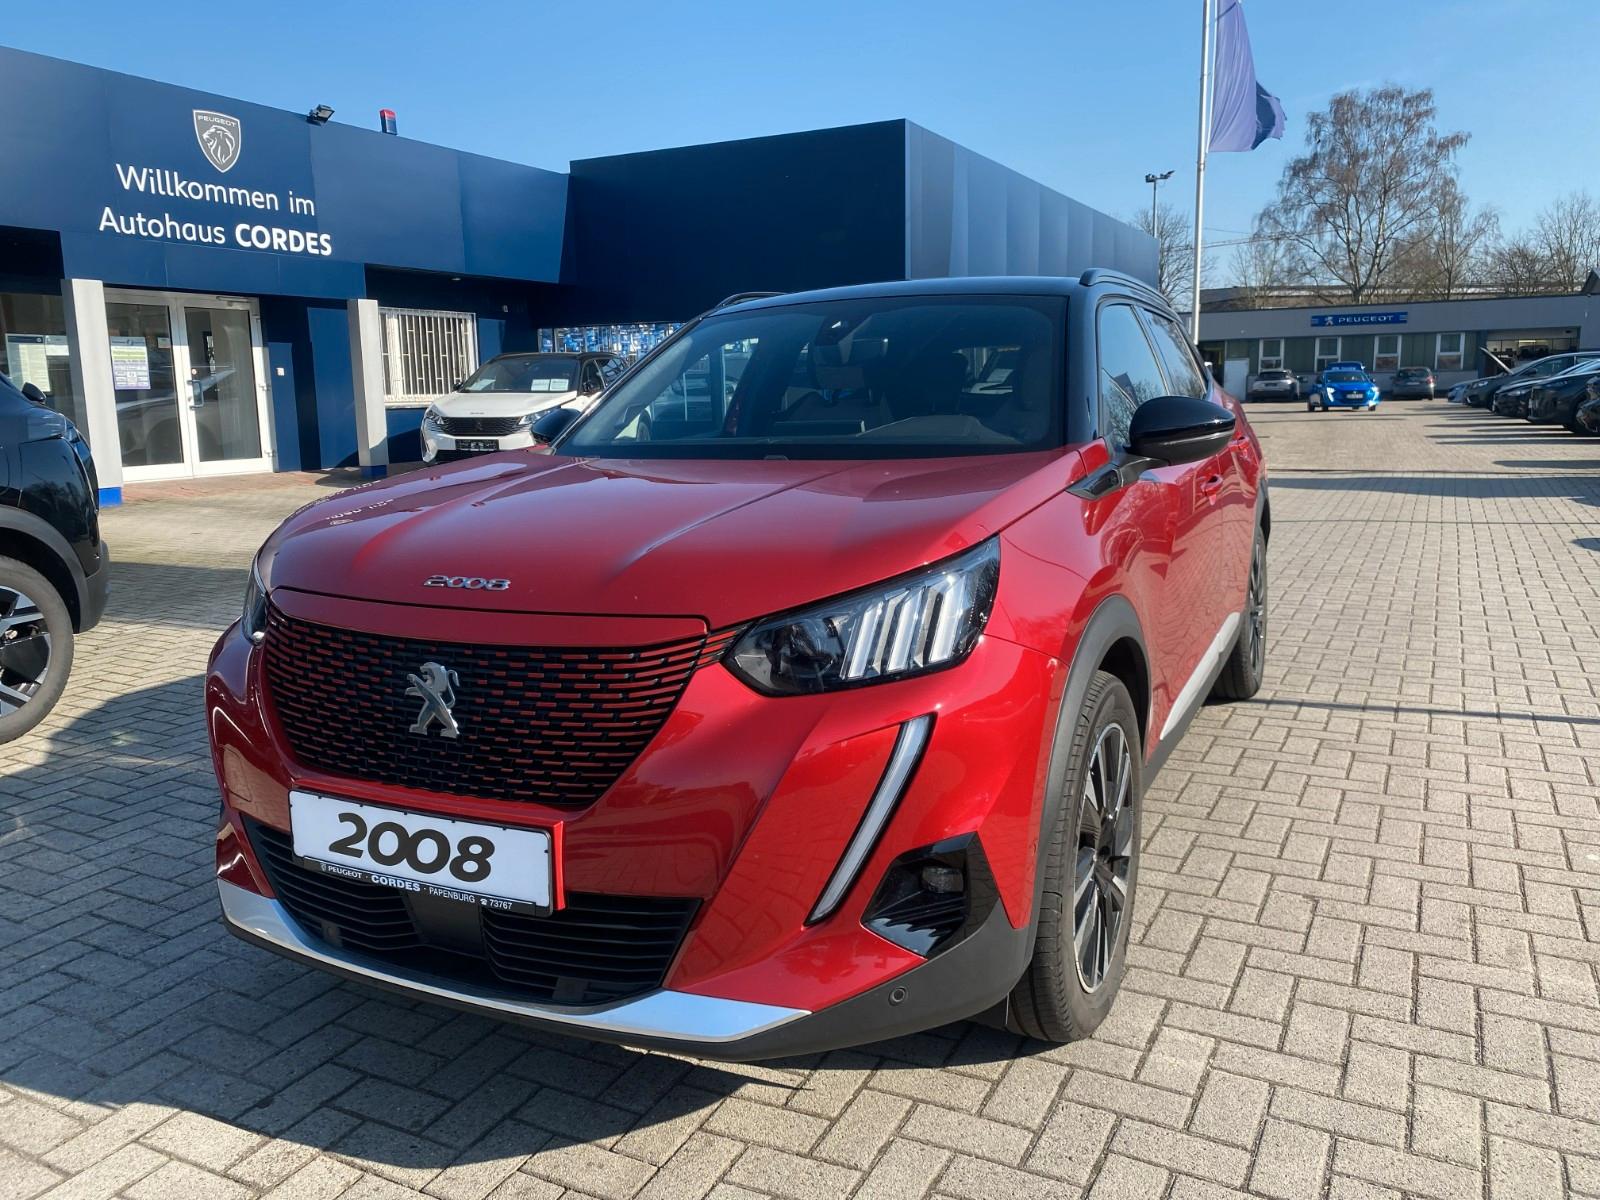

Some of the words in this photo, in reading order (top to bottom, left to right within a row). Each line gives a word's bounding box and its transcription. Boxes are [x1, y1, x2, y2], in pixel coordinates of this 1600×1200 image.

[197, 115, 237, 127] PEUGEOT
[115, 163, 279, 211] Willkommen
[288, 190, 316, 216] im
[98, 206, 226, 245] Autohaus
[235, 223, 333, 257] CORDES
[1338, 315, 1394, 323] PEUGEOT
[423, 574, 511, 591] 2008
[328, 812, 495, 882] 2008
[327, 865, 363, 879] PEUGEOT
[370, 874, 421, 892] CORDES
[428, 886, 476, 904] PAPENBURG
[489, 899, 513, 910] 73767
